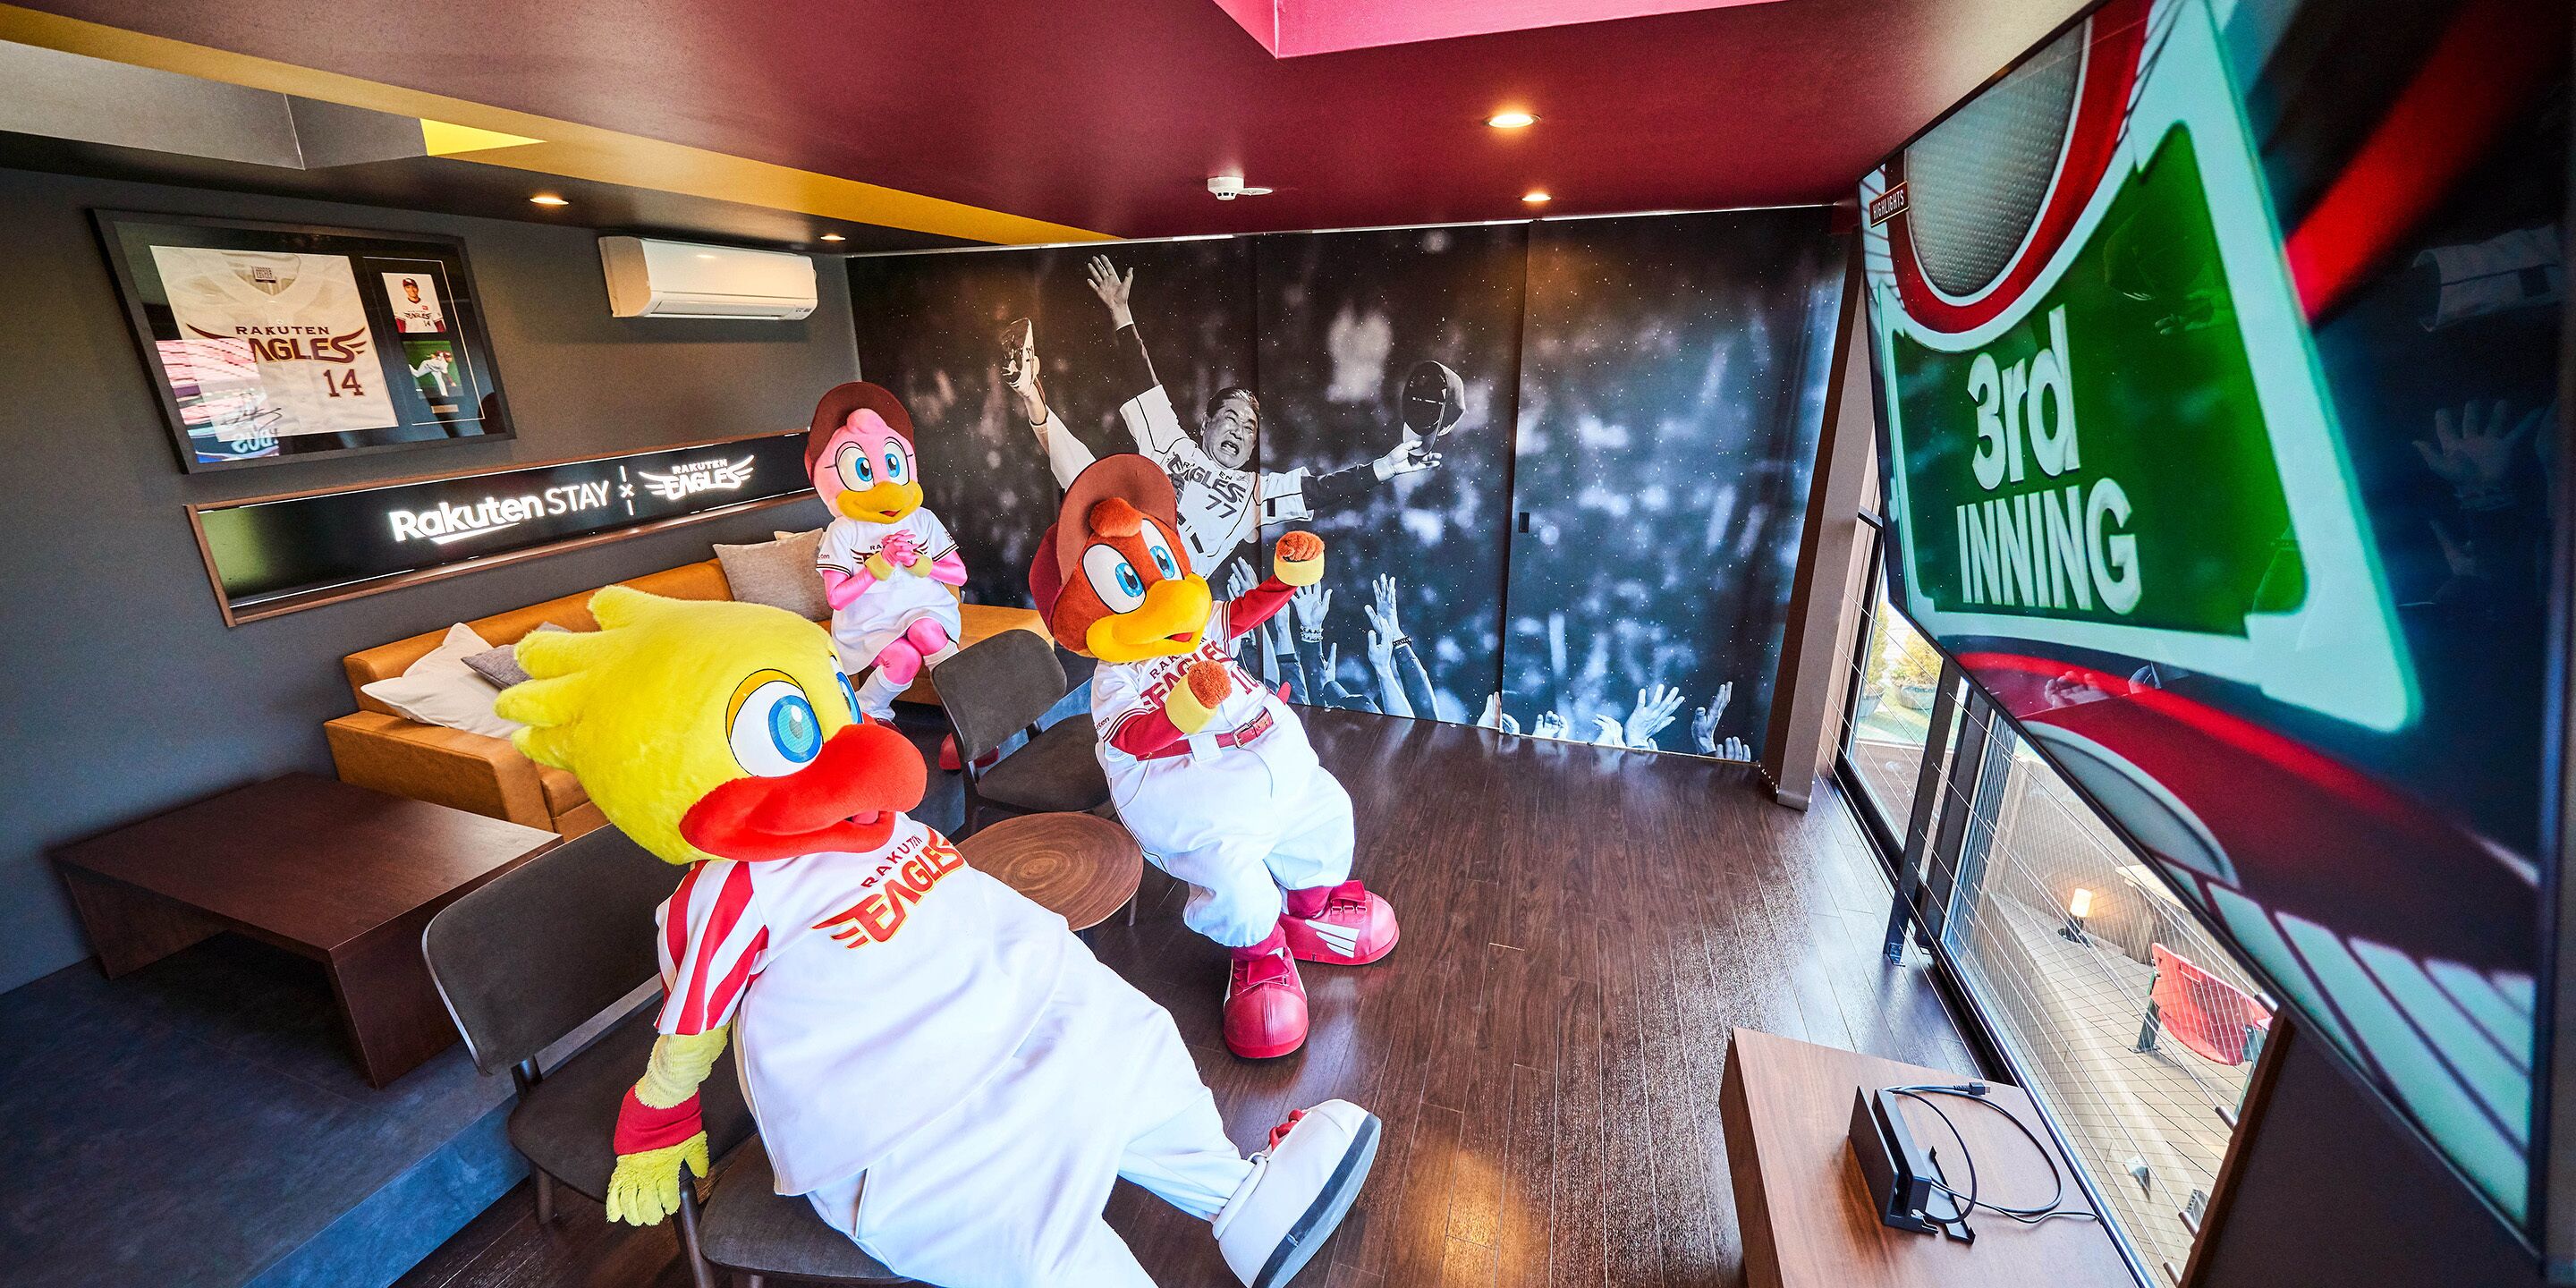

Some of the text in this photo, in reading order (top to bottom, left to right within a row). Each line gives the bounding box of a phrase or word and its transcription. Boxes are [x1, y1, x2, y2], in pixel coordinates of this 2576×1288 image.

[1873, 190, 1904, 220] HIGHLIGHTS
[235, 326, 330, 335] RAKUTEN
[323, 369, 366, 397] 14
[1968, 304, 2080, 490] 3rd
[657, 458, 753, 500] EAGLES
[672, 458, 728, 475] RAKUTEN
[388, 496, 545, 544] Rakuten
[545, 480, 610, 515] STAY
[1205, 494, 1238, 520] 77
[1956, 477, 2142, 615] INNING
[841, 826, 965, 944] EAGLES
